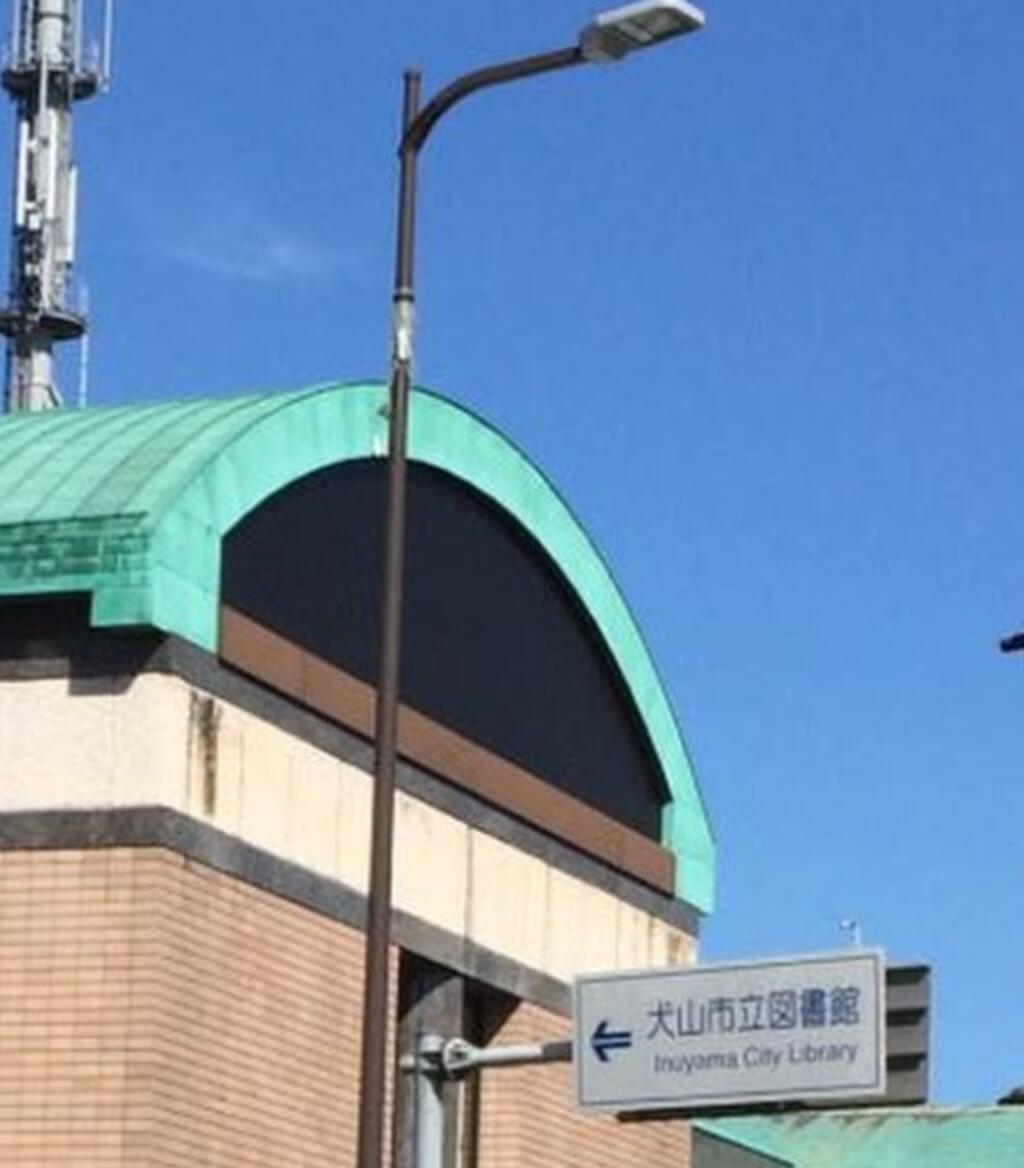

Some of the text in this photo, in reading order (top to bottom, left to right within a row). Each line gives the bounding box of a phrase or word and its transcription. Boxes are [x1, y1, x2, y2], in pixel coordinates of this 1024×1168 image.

[646, 986, 861, 1041] 犬山市立図書館
[654, 1042, 860, 1076] Inuyama City Library
